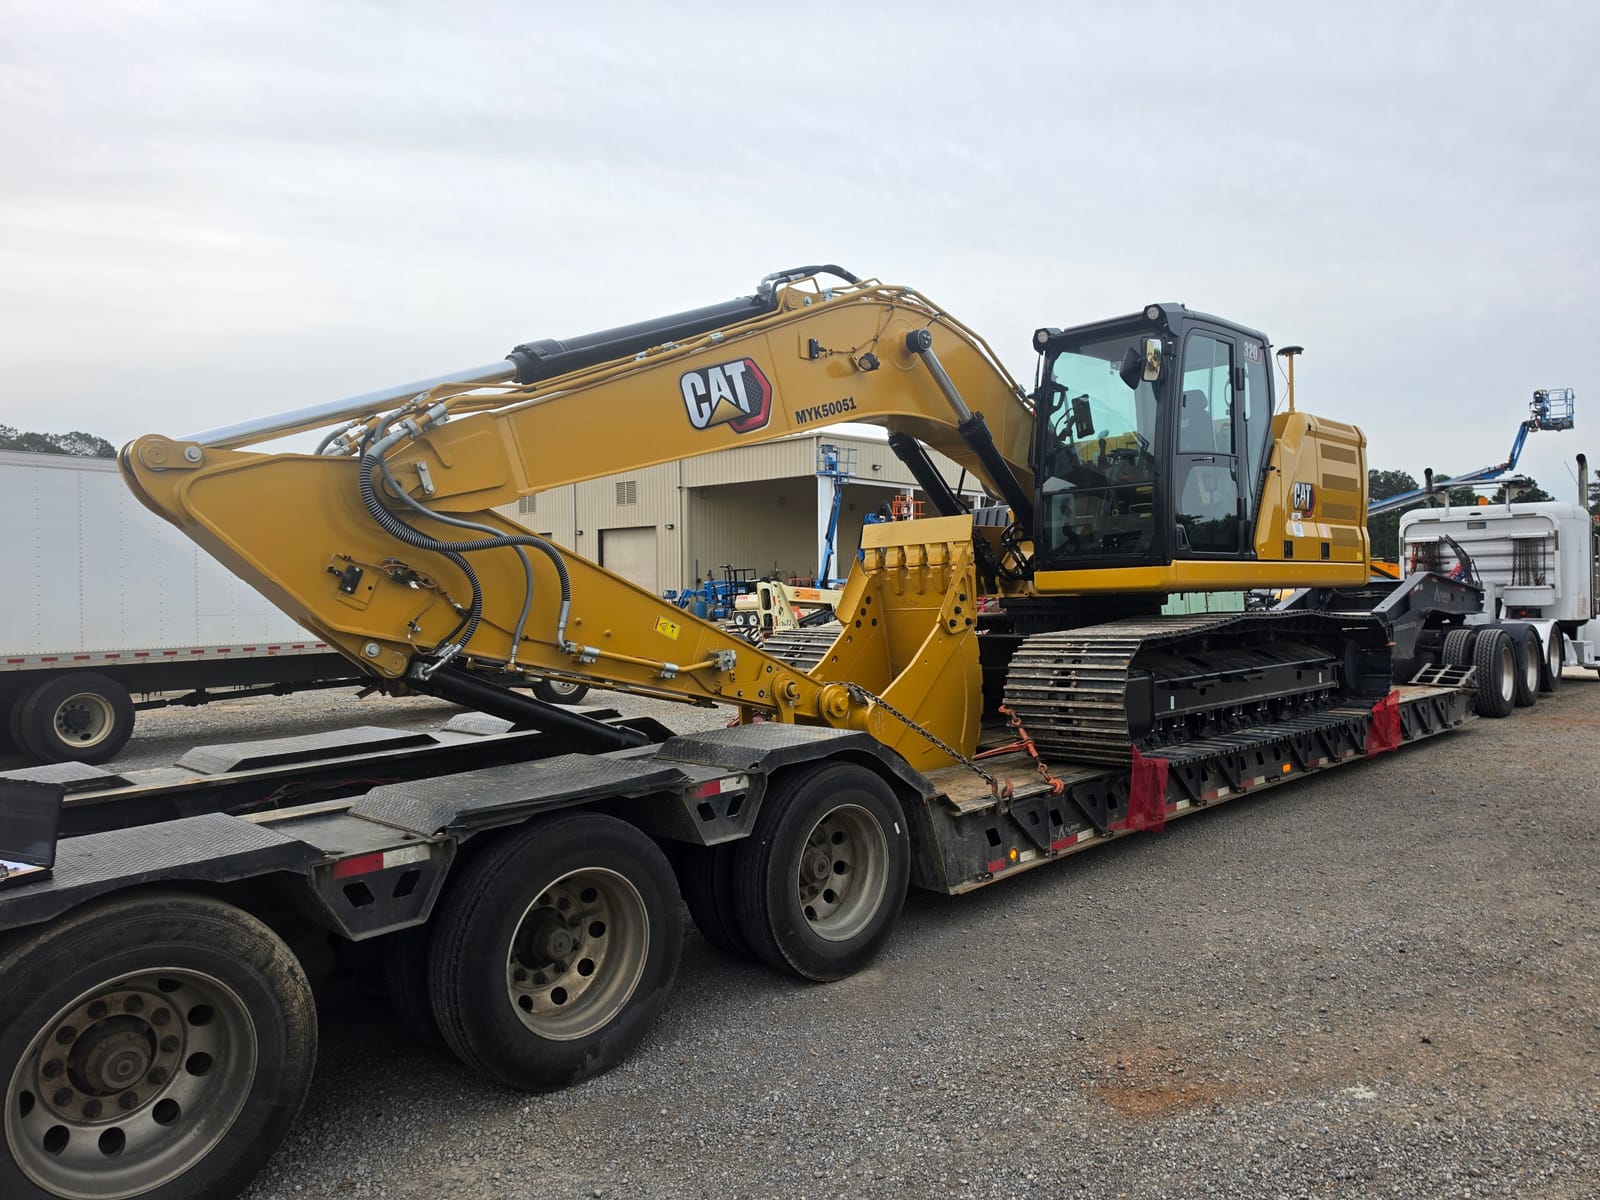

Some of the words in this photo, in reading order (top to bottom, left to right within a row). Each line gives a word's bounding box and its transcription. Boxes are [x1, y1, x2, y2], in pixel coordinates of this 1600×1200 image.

[1243, 341, 1258, 361] 320
[681, 360, 751, 428] CAT
[795, 397, 857, 425] MYK50051
[1293, 482, 1312, 510] CAT
